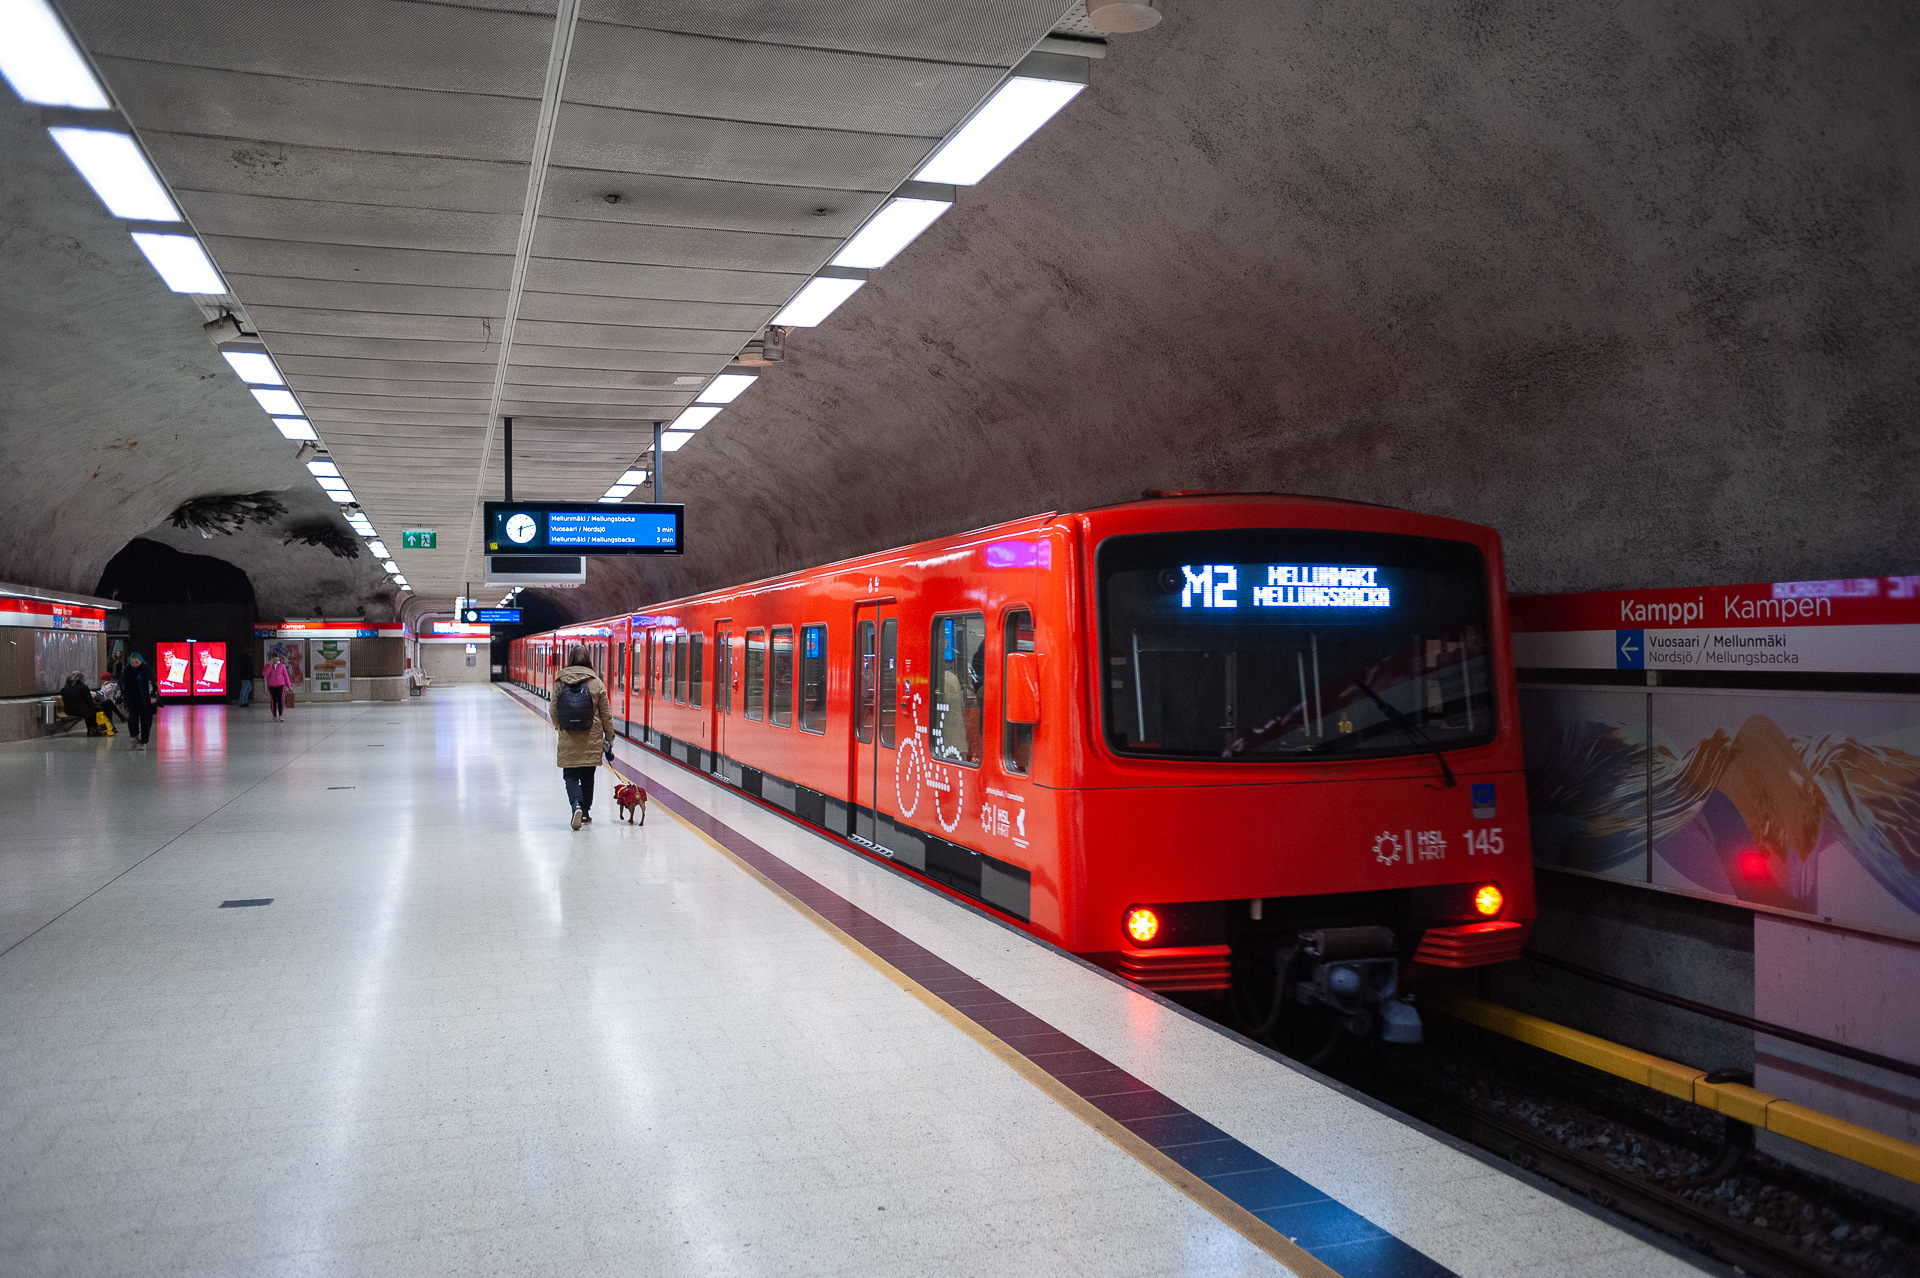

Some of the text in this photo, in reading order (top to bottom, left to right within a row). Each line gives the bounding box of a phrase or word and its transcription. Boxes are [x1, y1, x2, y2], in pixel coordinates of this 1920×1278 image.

[591, 515, 636, 523] Mellungsbacka
[583, 525, 606, 534] Nordsjö
[591, 536, 636, 544] Mellungsbacka
[1181, 564, 1238, 608] M2
[1620, 595, 1832, 625] Kamppi Kampen
[1649, 633, 1787, 650] Vuosaari / Mellunmäki
[1649, 650, 1799, 667] Nordsjö / Mellungsbacka
[1336, 720, 1353, 734] 10
[1417, 830, 1447, 845] HSL
[1462, 827, 1504, 856] 145
[1418, 845, 1447, 861] HRT
